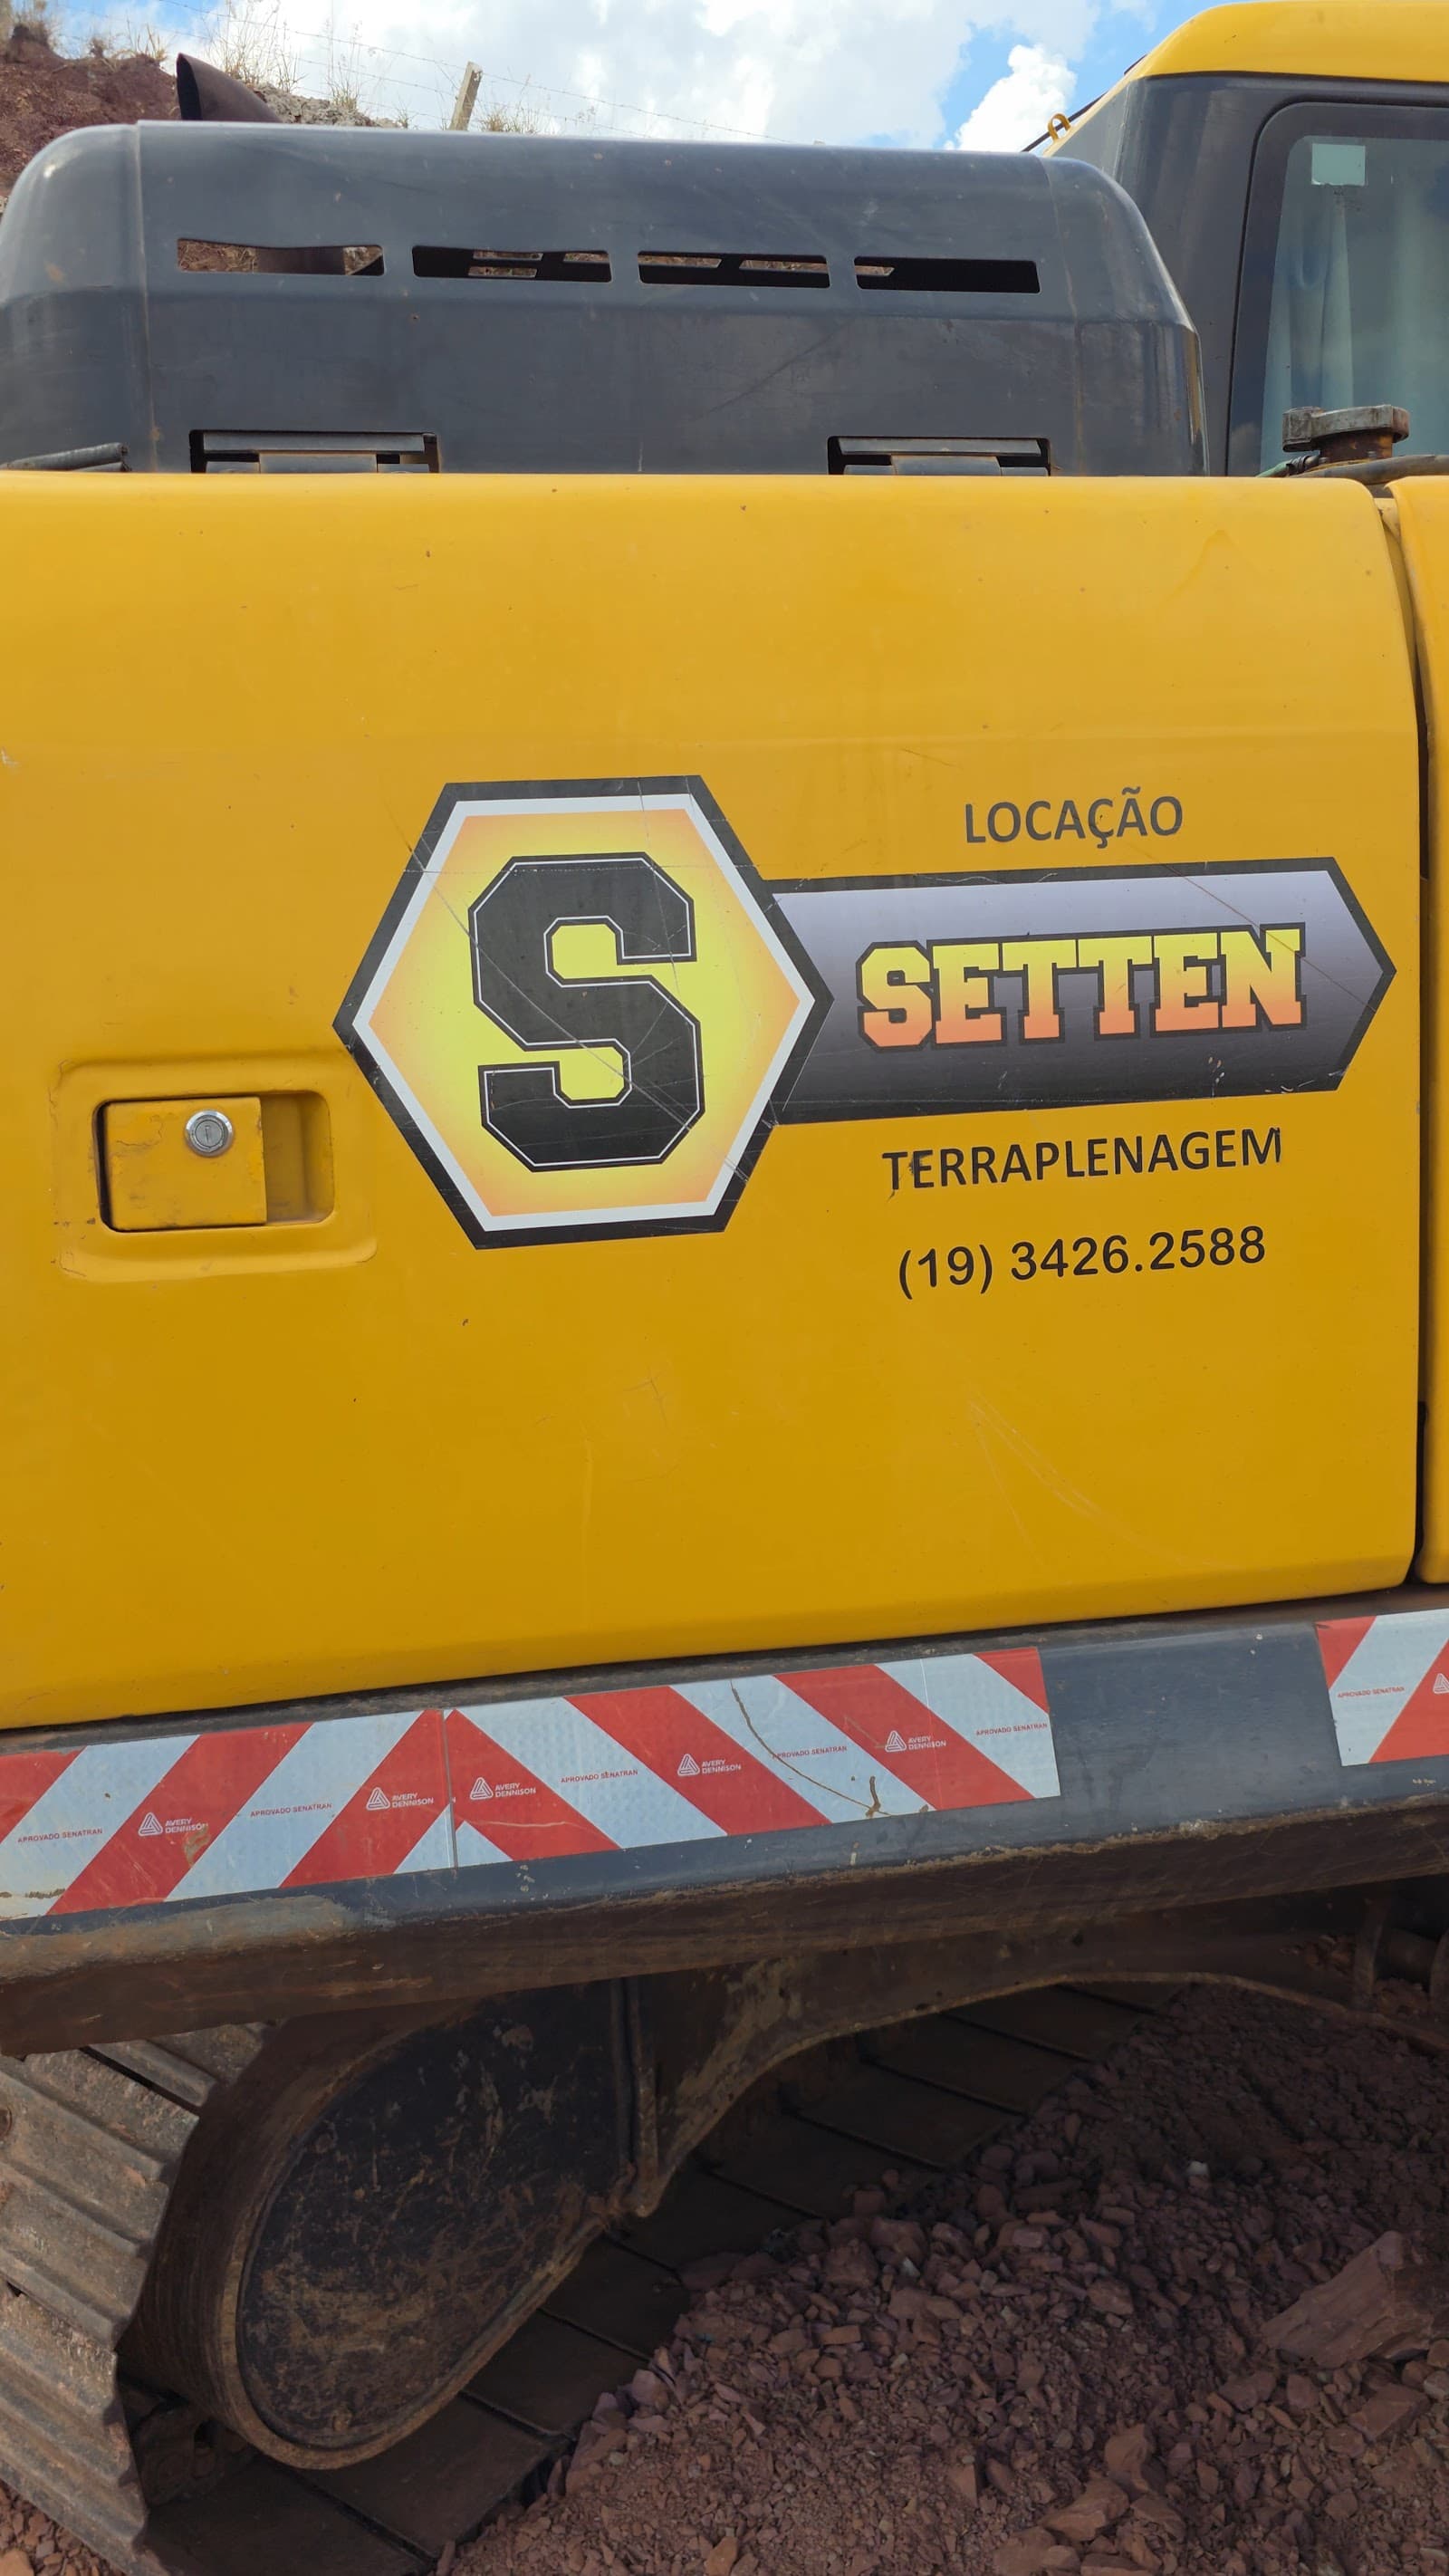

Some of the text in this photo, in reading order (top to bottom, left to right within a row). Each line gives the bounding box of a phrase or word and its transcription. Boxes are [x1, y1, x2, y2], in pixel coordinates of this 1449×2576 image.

[964, 786, 1183, 849] LOCAÇÃO
[858, 923, 1306, 1053] SETTEN
[469, 852, 705, 1173] S
[883, 1127, 1282, 1190] TERRAPLENAGEM
[898, 1226, 1266, 1299] (19) 3426.2588
[976, 1723, 1048, 1735] APROVADO SENATRAN
[908, 1735, 931, 1744] AVERY
[908, 1740, 946, 1750] DENNISON
[811, 1745, 847, 1754] SENATRAN
[702, 1759, 725, 1767] AVERY
[702, 1764, 742, 1774] DENNISON
[561, 1769, 638, 1783] APROVADO SENATRAN
[494, 1783, 521, 1791] AVERY
[495, 1787, 537, 1798] DENNISON
[392, 1793, 417, 1801] AVERY
[392, 1797, 434, 1808] DENNISON
[250, 1802, 332, 1817] APROVADO SENATRAN
[166, 1817, 192, 1826] AVERY
[17, 1828, 102, 1842] APROVADO SENATRAN
